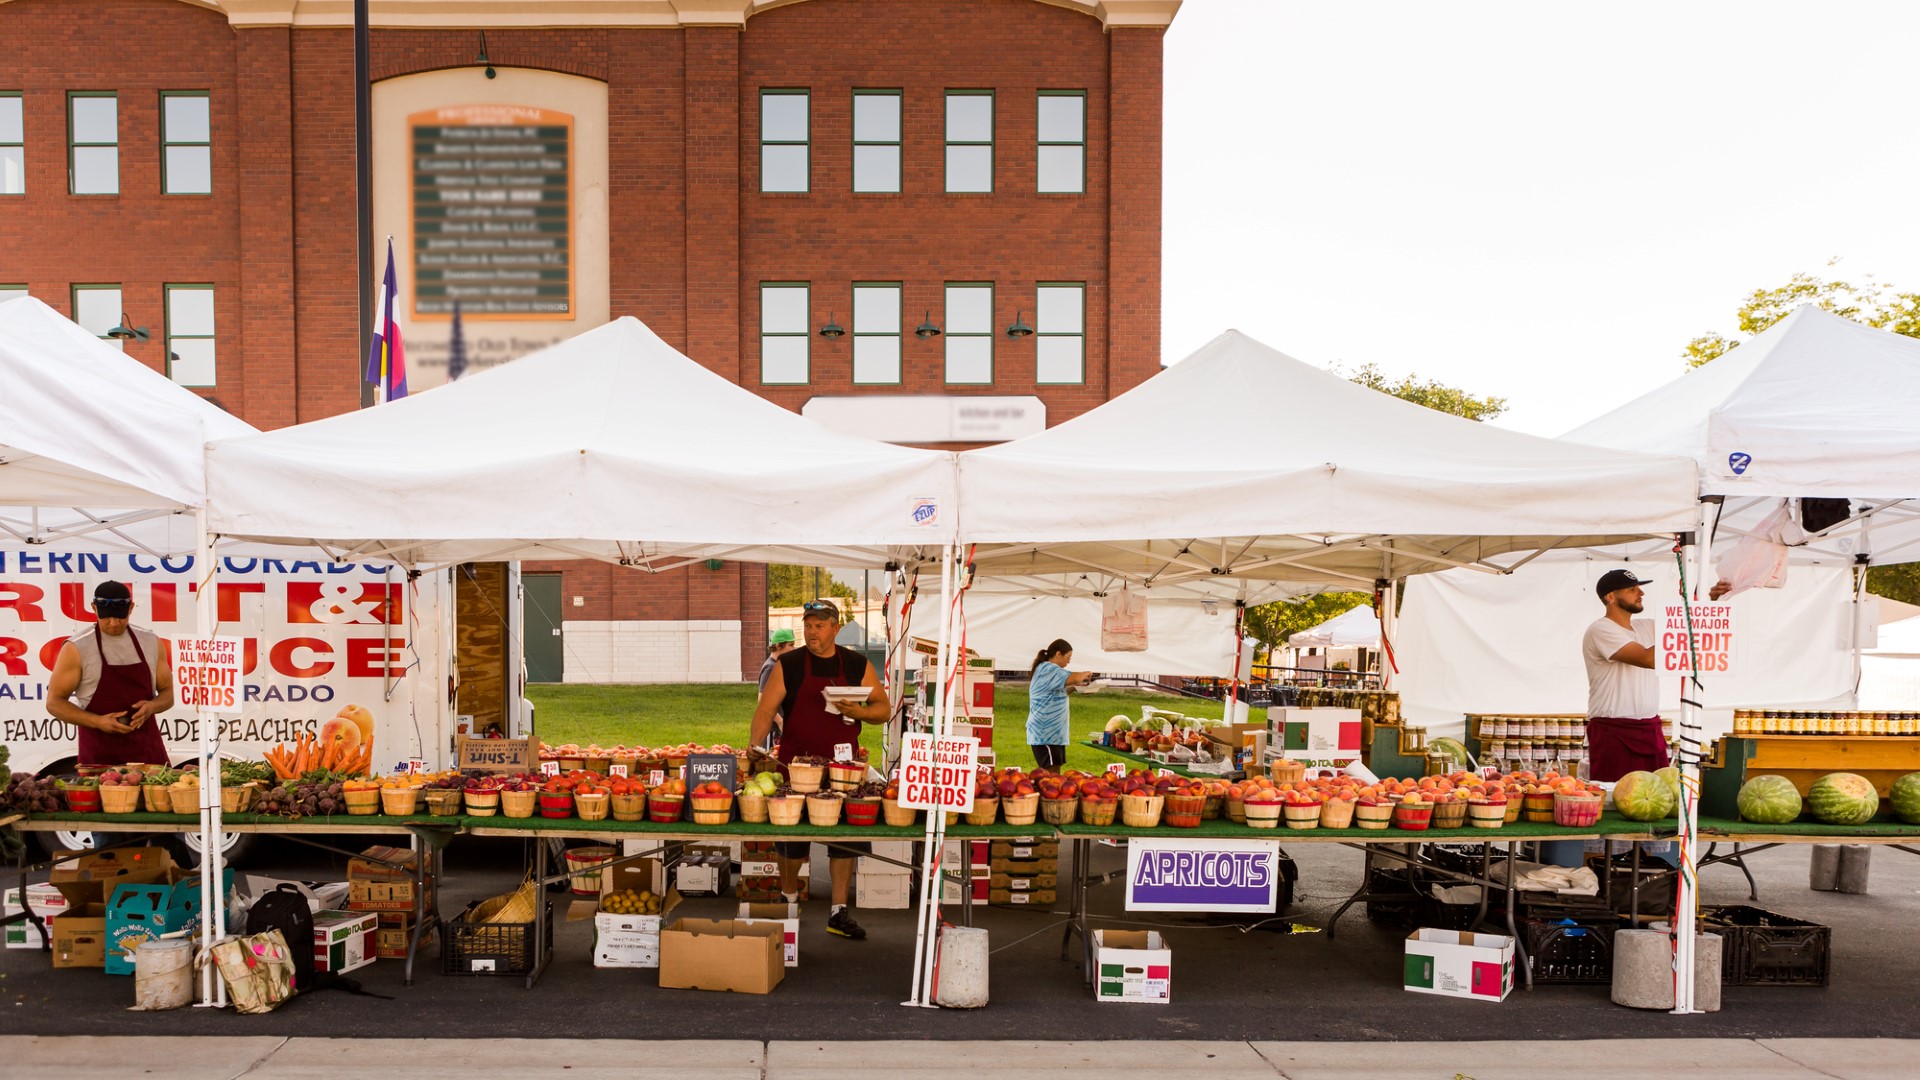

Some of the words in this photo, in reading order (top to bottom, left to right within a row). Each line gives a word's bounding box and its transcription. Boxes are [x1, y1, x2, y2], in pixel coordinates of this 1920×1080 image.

[1665, 606, 1683, 617] WE
[1687, 606, 1731, 617] ACCEPT
[1666, 618, 1686, 629] ALL
[1690, 618, 1729, 629] MAJOR
[178, 639, 192, 651] WE
[195, 640, 237, 653] ACCEPT
[1662, 632, 1732, 652] CREDIT
[179, 652, 195, 663] ALL
[198, 652, 235, 664] MAJOR
[1665, 652, 1729, 672] CARDS
[178, 665, 238, 687] CREDIT
[181, 685, 235, 707] CARDS
[911, 738, 926, 750] WE
[930, 740, 971, 753] ACCEPT
[470, 752, 521, 765] T-Shirt
[910, 751, 928, 762] ALL
[932, 752, 969, 765] MAJOR
[693, 763, 729, 774] FARMER'S
[905, 765, 971, 787] CREDIT
[906, 784, 967, 807] CARDS
[1134, 849, 1272, 888] APRICOTS
